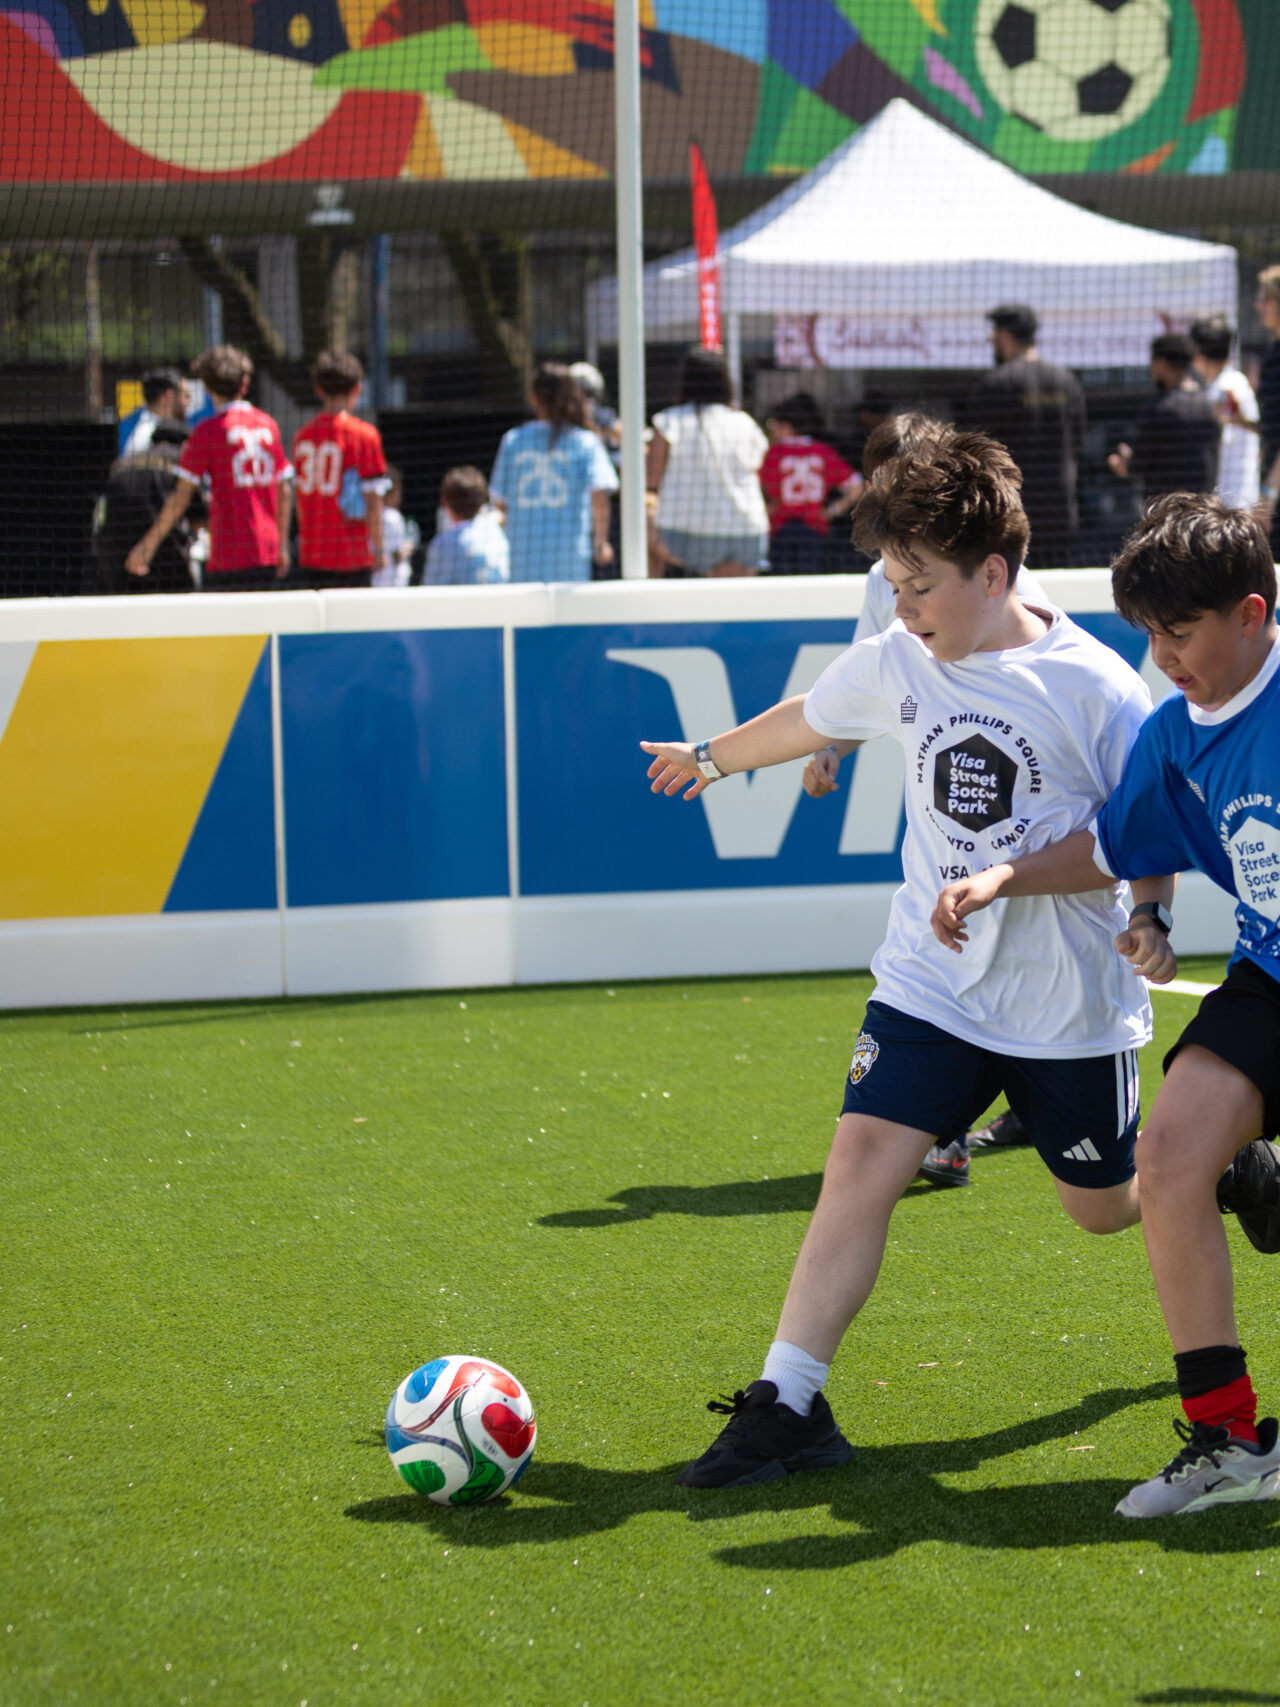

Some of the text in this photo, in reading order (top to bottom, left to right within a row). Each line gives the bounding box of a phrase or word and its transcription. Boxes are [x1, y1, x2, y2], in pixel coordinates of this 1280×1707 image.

[227, 425, 275, 488] 26
[296, 440, 343, 496] 30
[779, 454, 824, 505] 26
[917, 713, 1042, 794] NATHAN PHILLIPS SQUARE
[950, 752, 986, 770] Visa
[950, 768, 998, 787] Street
[948, 799, 989, 815] Park
[1222, 793, 1273, 822] PHILLIPS
[1235, 840, 1265, 857] Visa
[1239, 852, 1280, 873] Street
[1250, 886, 1278, 904] Park
